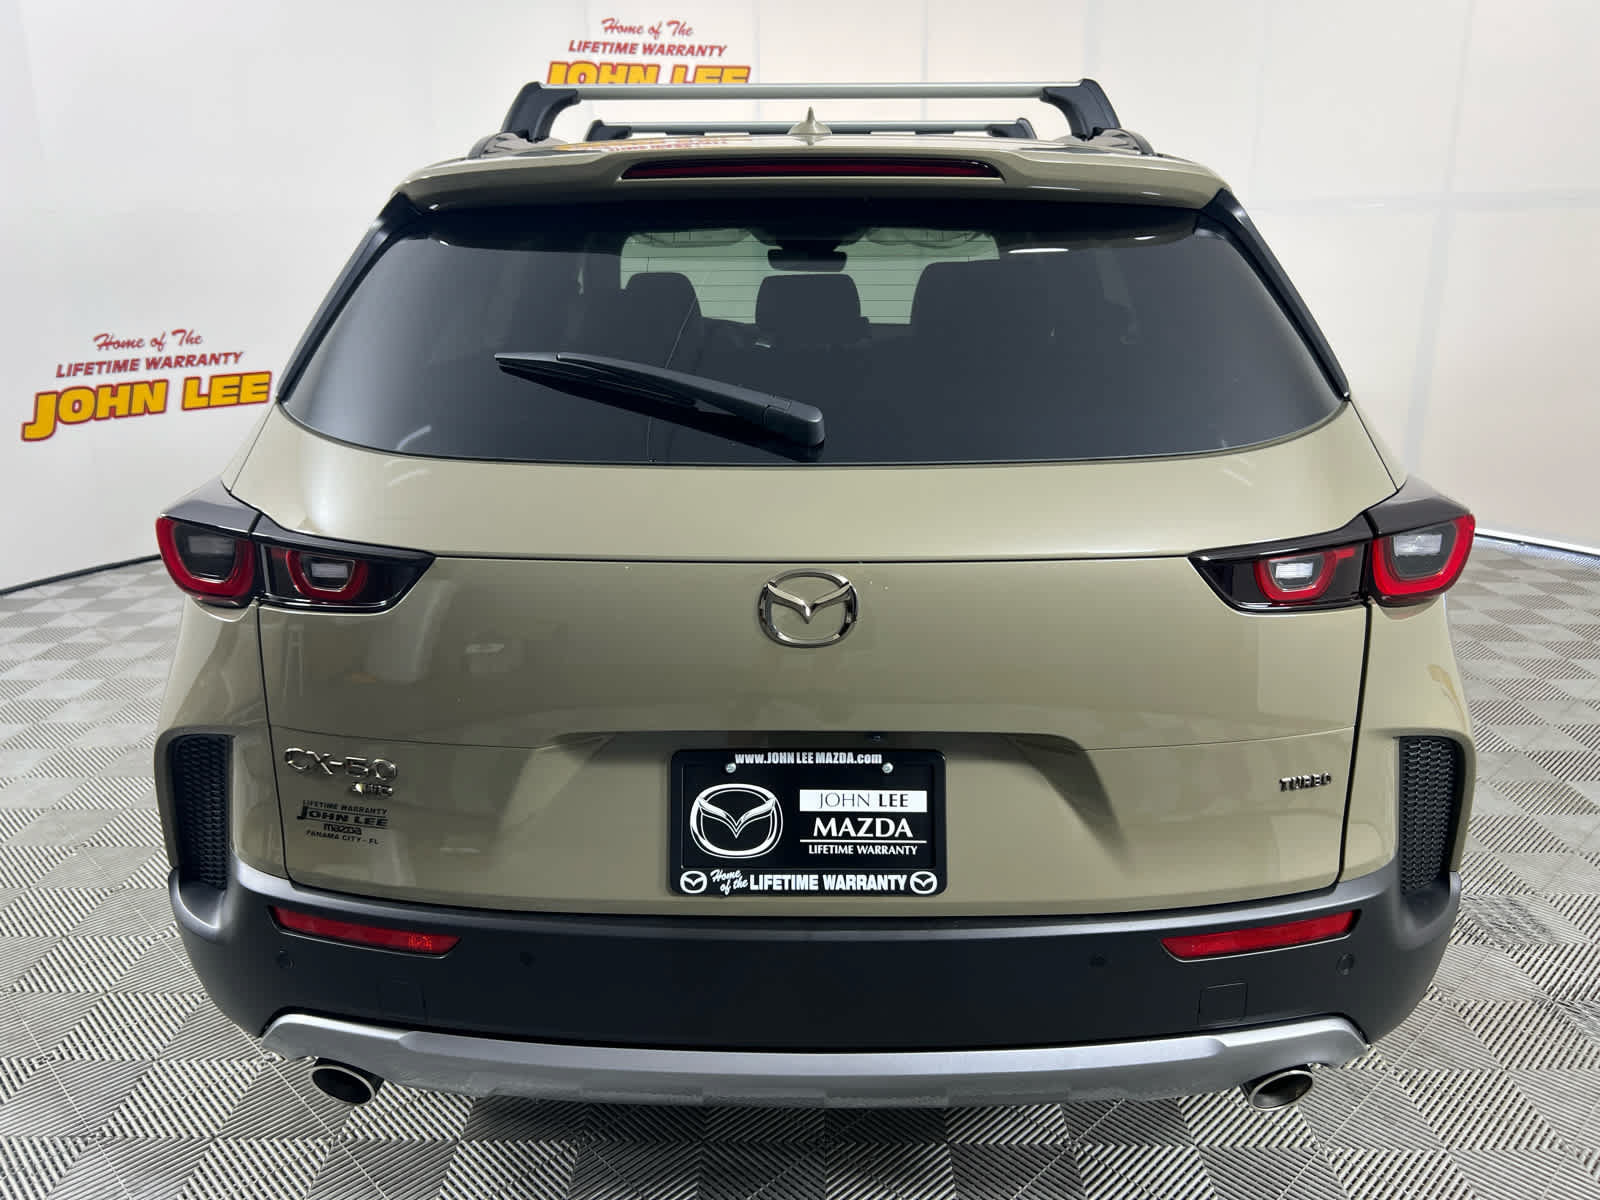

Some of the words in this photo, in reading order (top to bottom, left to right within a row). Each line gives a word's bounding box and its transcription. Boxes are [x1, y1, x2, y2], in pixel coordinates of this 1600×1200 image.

[601, 17, 644, 36] Home
[647, 21, 663, 41] of
[666, 19, 694, 37] The
[568, 39, 639, 55] LIFETIME
[642, 43, 728, 58] WARRANTY
[93, 332, 145, 351] Home
[150, 333, 167, 351] of
[171, 328, 202, 347] The
[55, 358, 140, 378] LIFETIME
[145, 351, 244, 371] WARRANTY
[21, 379, 169, 442] JOHN
[181, 371, 272, 411] LEE
[285, 747, 398, 781] CX-50
[1279, 772, 1332, 792] TURBO
[303, 800, 338, 809] LIFETIME
[341, 805, 388, 815] WARRANTY
[820, 792, 870, 809] JOHN
[878, 793, 909, 808] LEE
[296, 806, 349, 821] JOHN
[354, 816, 389, 826] LEE
[306, 830, 339, 840] PANAMA
[813, 817, 913, 838] MAZDA
[809, 844, 854, 855] LIFETIME
[857, 845, 918, 855] WARRANTY
[710, 868, 742, 884] Home
[720, 881, 732, 895] of
[732, 876, 749, 890] the
[750, 874, 821, 891] LIFETIME
[823, 874, 908, 891] WARRANTY
